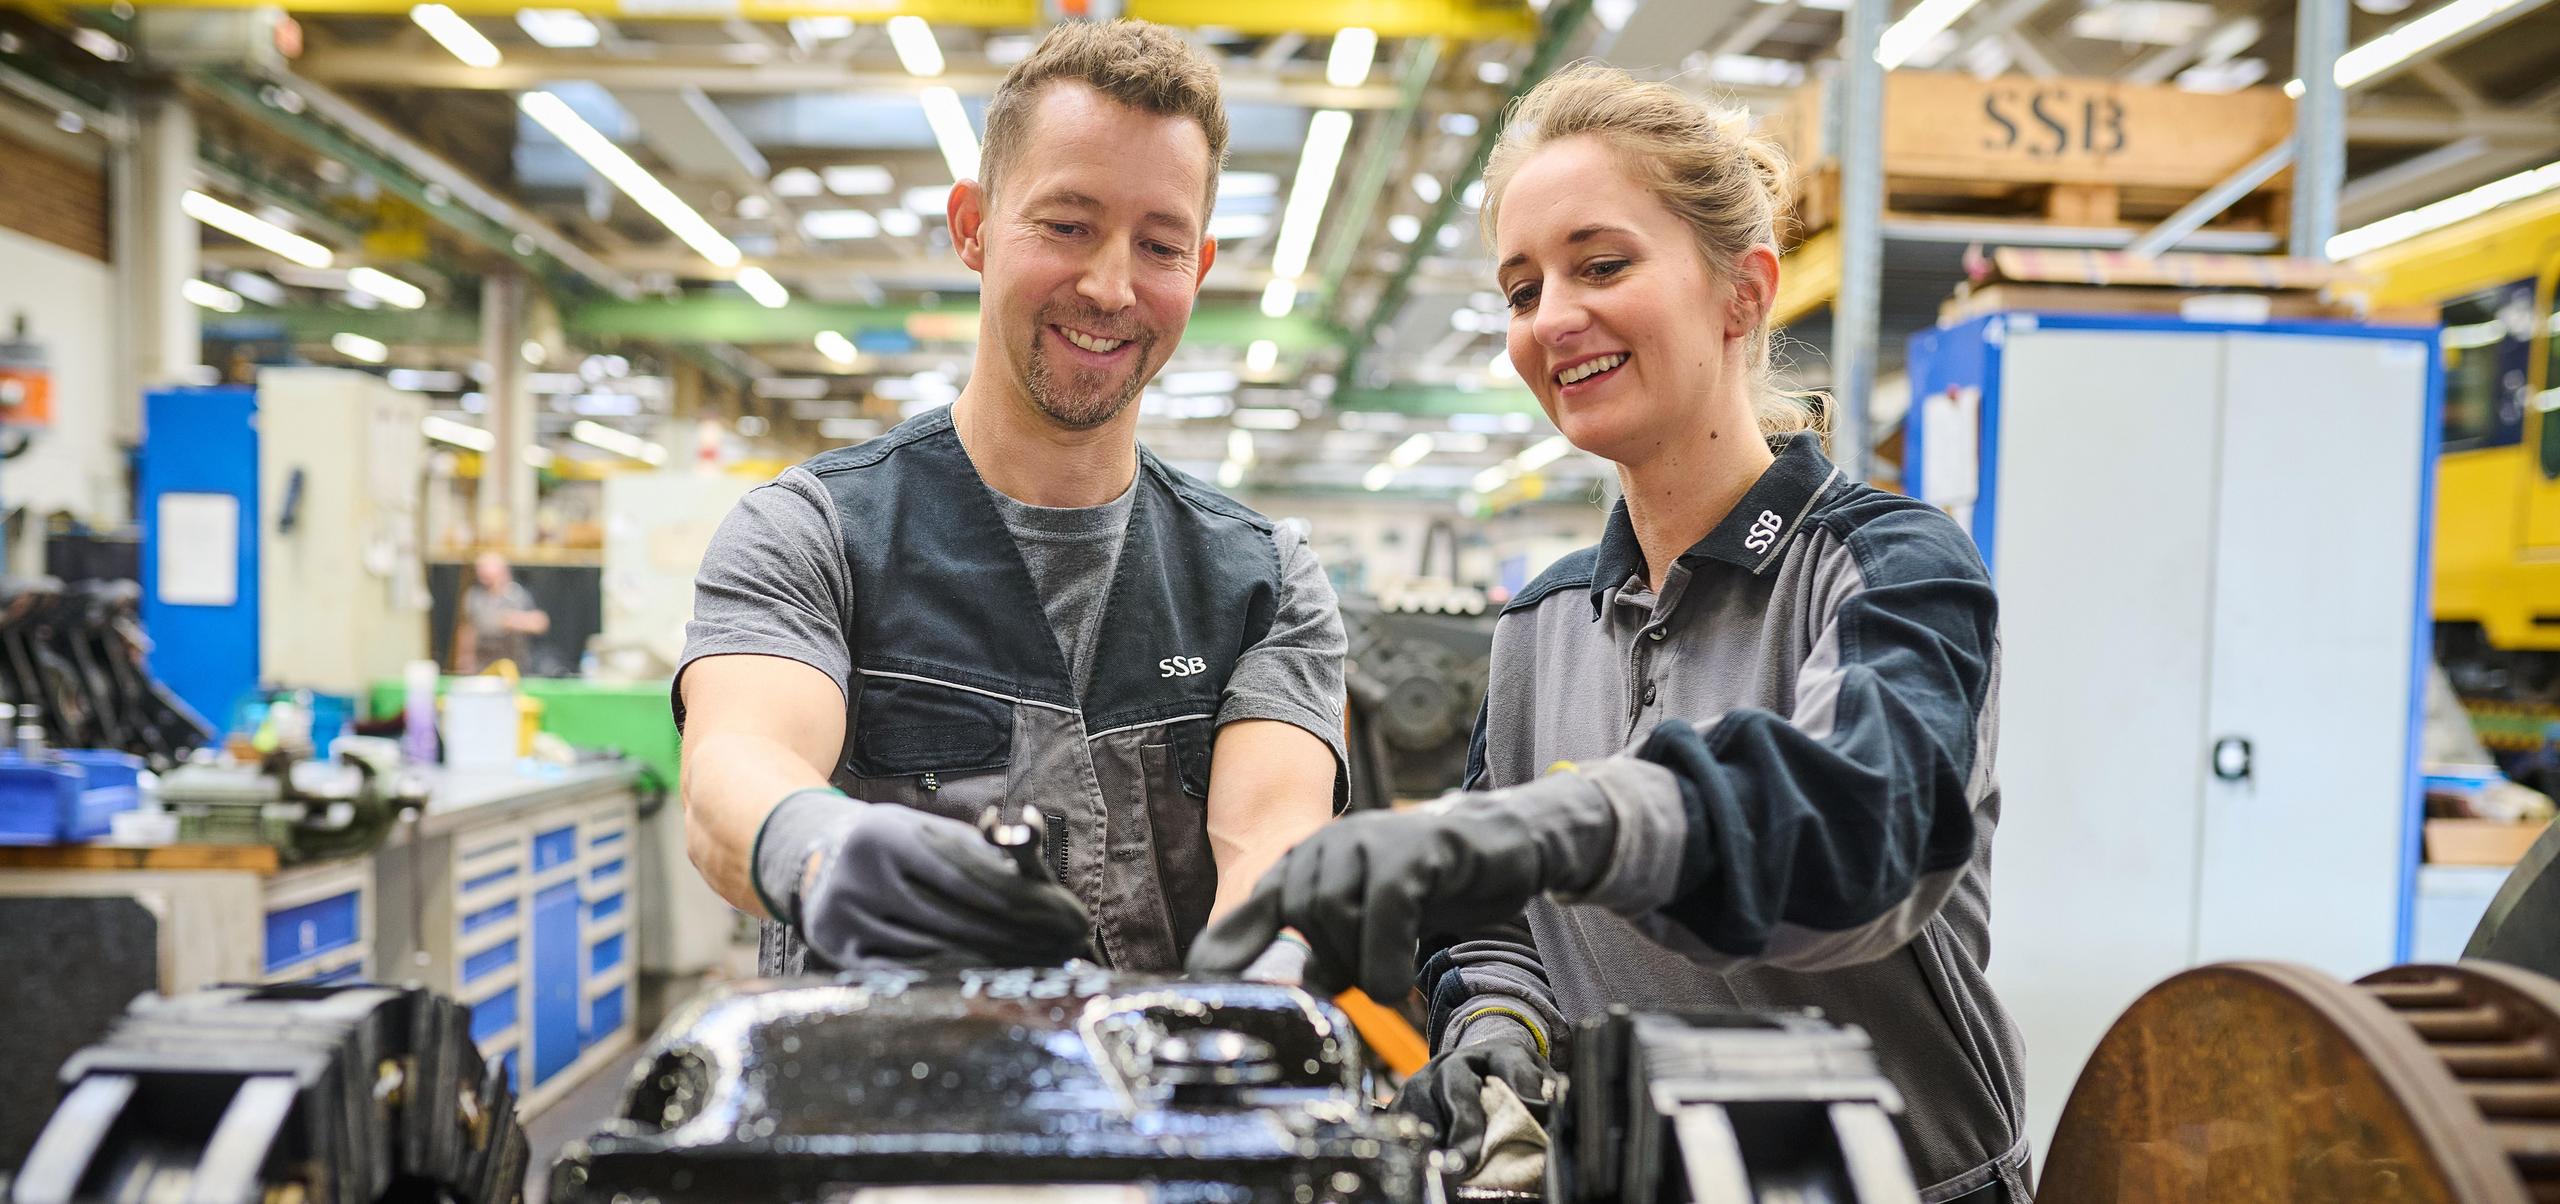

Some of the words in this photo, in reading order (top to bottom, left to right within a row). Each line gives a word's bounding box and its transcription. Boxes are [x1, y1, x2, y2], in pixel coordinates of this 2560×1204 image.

[1982, 89, 2127, 156] SSB
[1744, 509, 1783, 555] SSB
[1159, 655, 1207, 678] SSB
